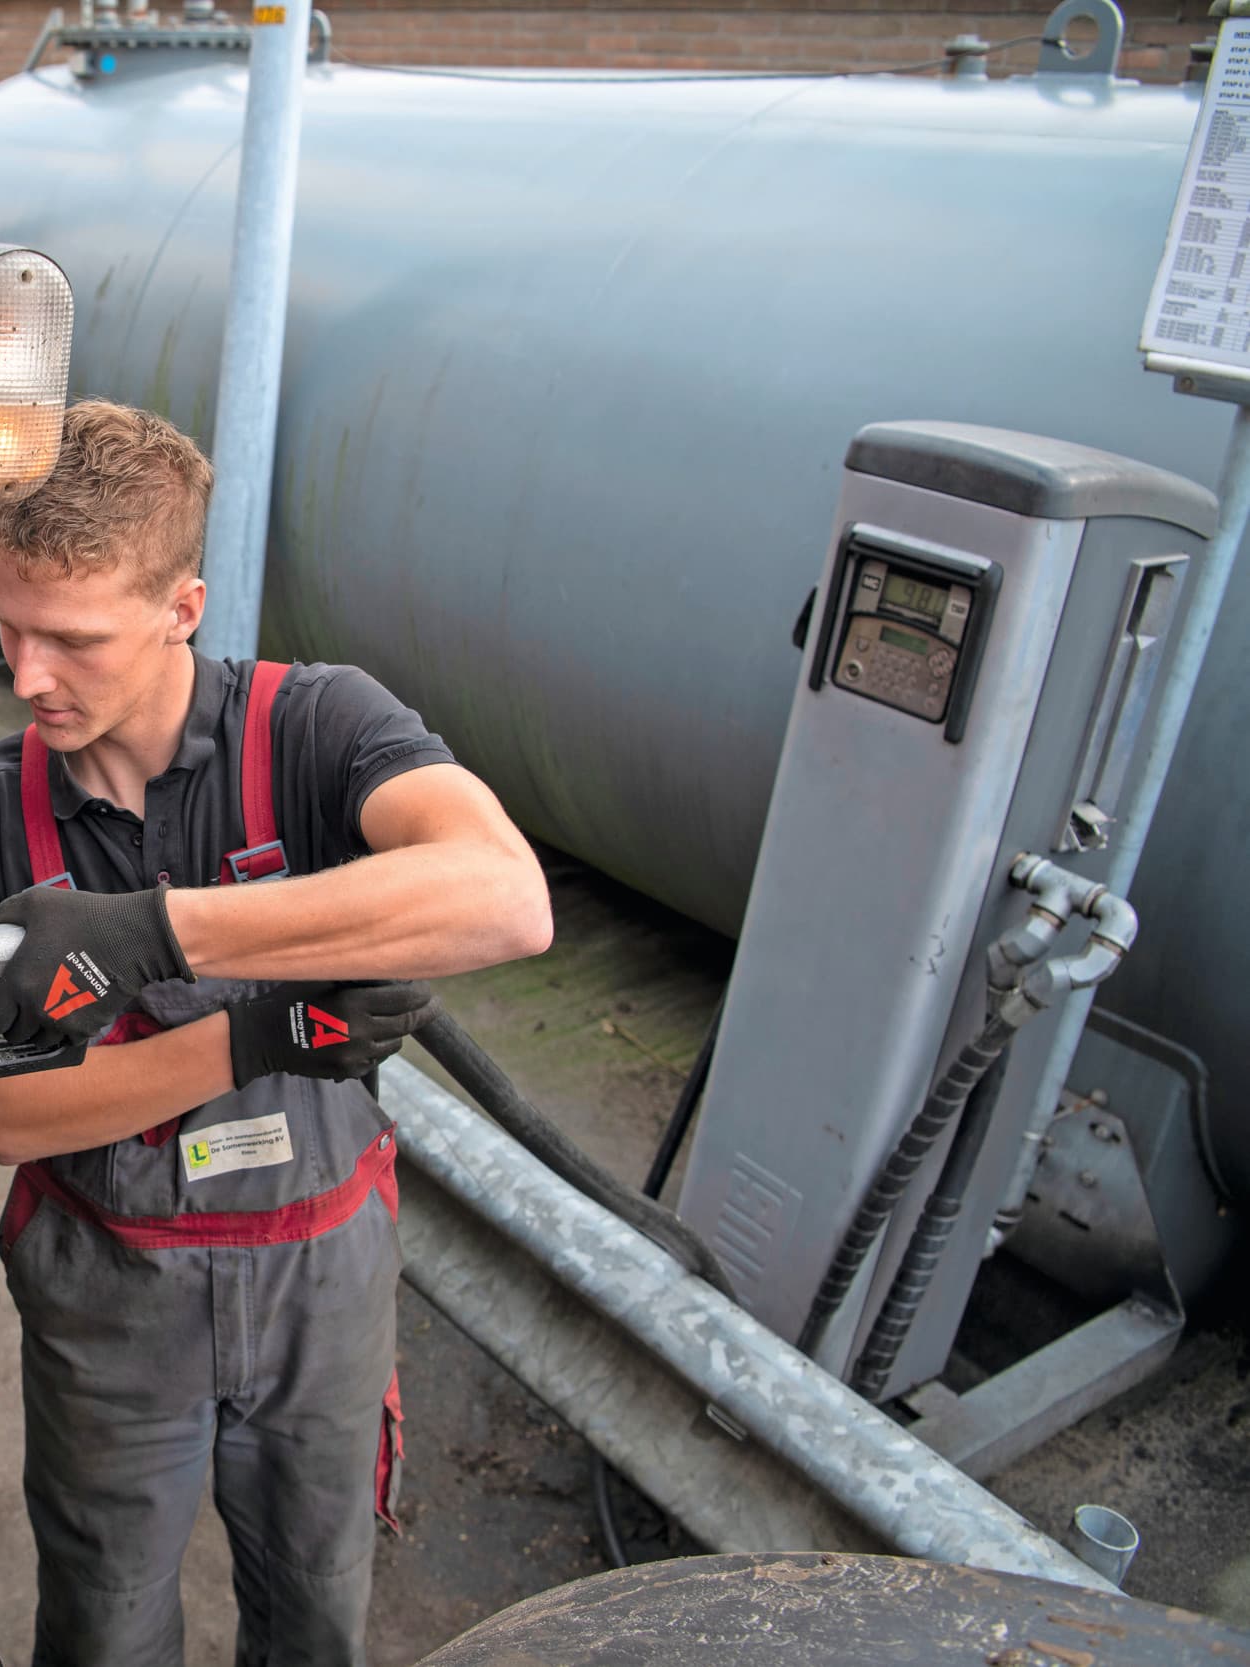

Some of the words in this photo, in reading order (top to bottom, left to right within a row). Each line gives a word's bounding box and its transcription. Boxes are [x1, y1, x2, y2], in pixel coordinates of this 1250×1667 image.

[65, 951, 108, 998] Honeywell
[295, 1001, 309, 1049] Honeywell
[222, 1138, 274, 1152] Samenwerking
